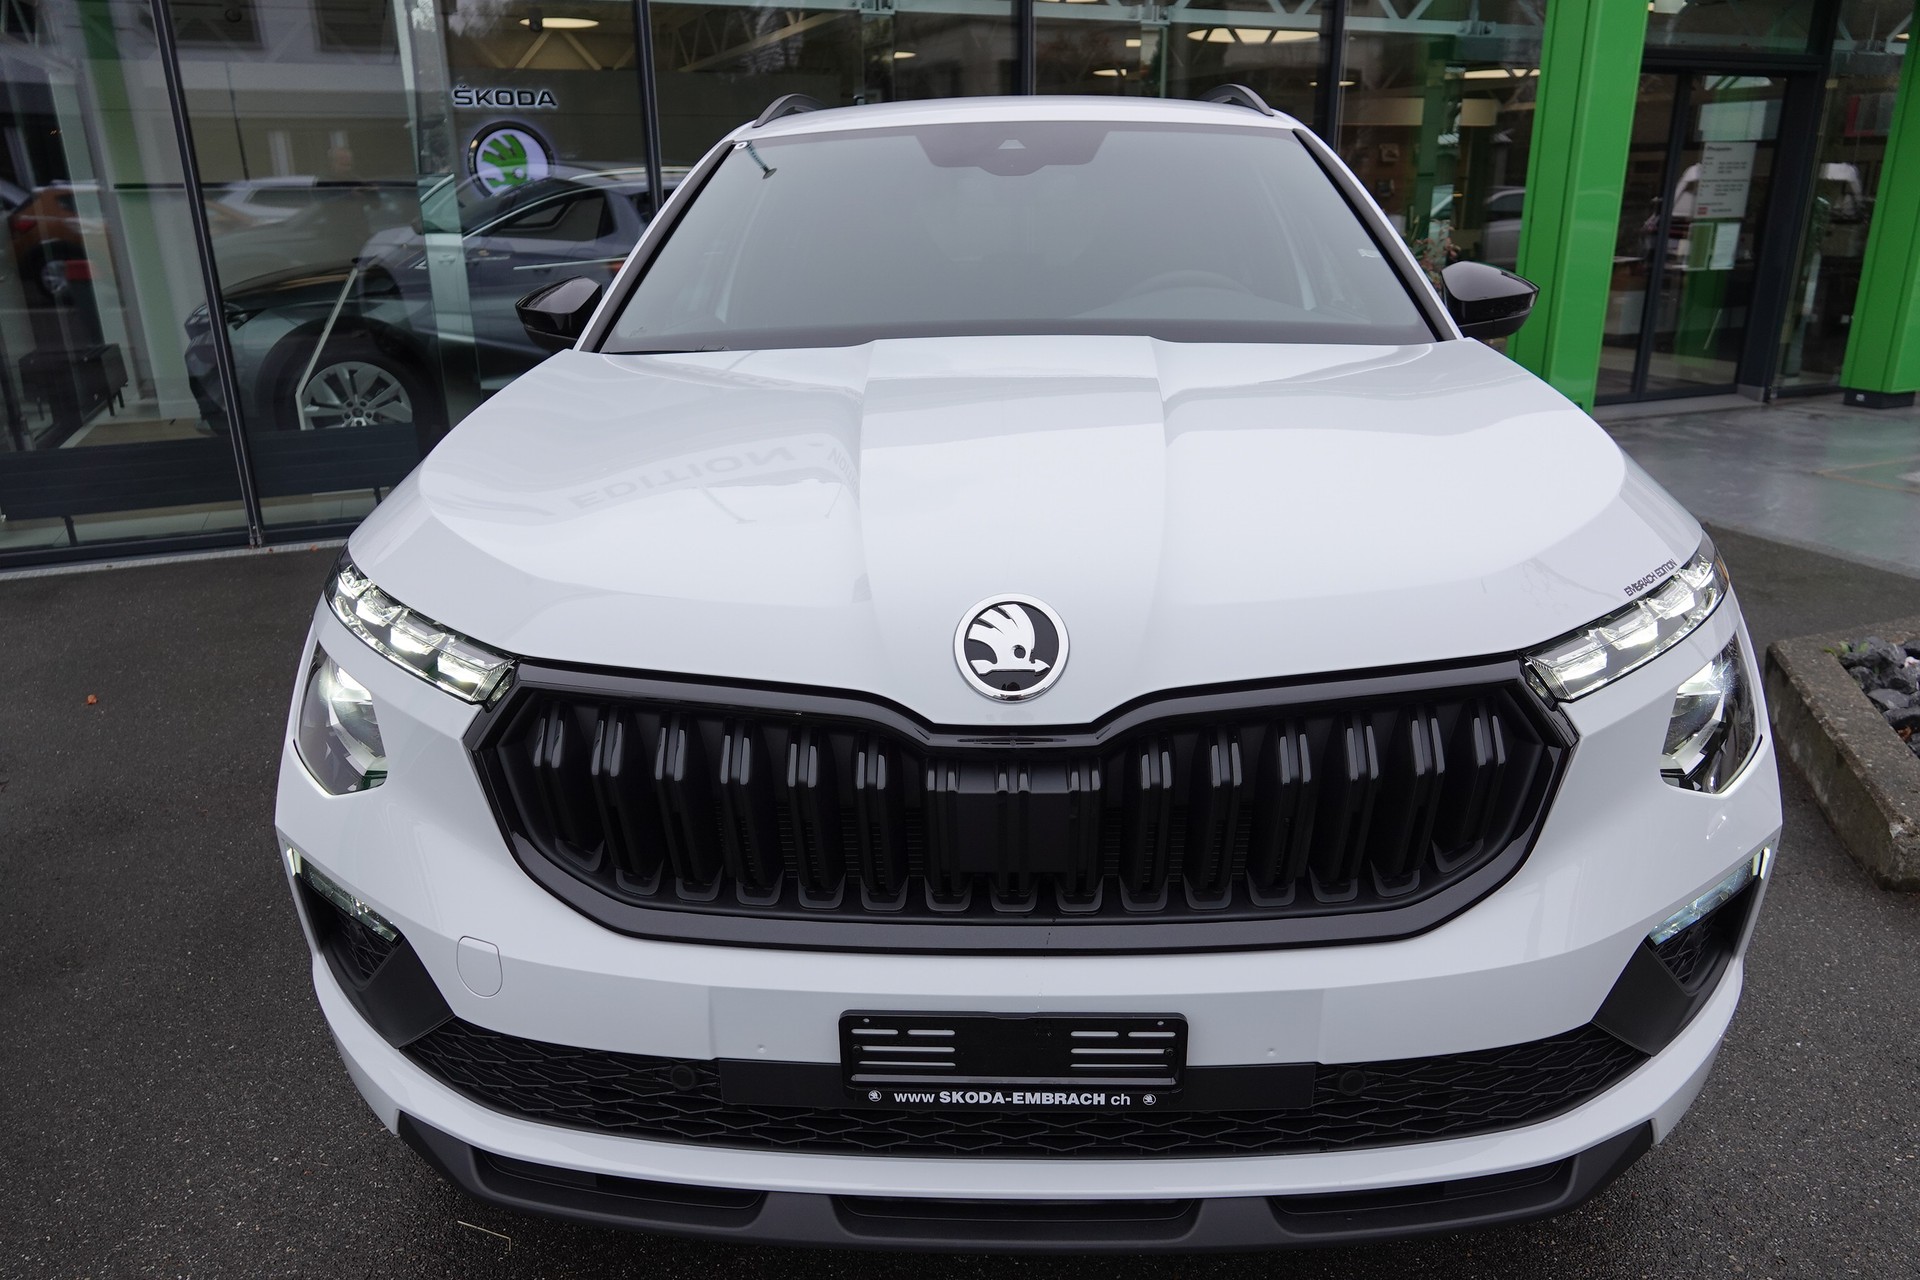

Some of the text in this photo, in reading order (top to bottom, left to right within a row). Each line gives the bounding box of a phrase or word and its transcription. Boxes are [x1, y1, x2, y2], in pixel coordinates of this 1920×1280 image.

[453, 85, 558, 107] ŠKODA
[1624, 558, 1677, 597] EMBRACH EDITION
[939, 1091, 1106, 1106] SKODA-EMBRACH
[1110, 1093, 1131, 1106] ch
